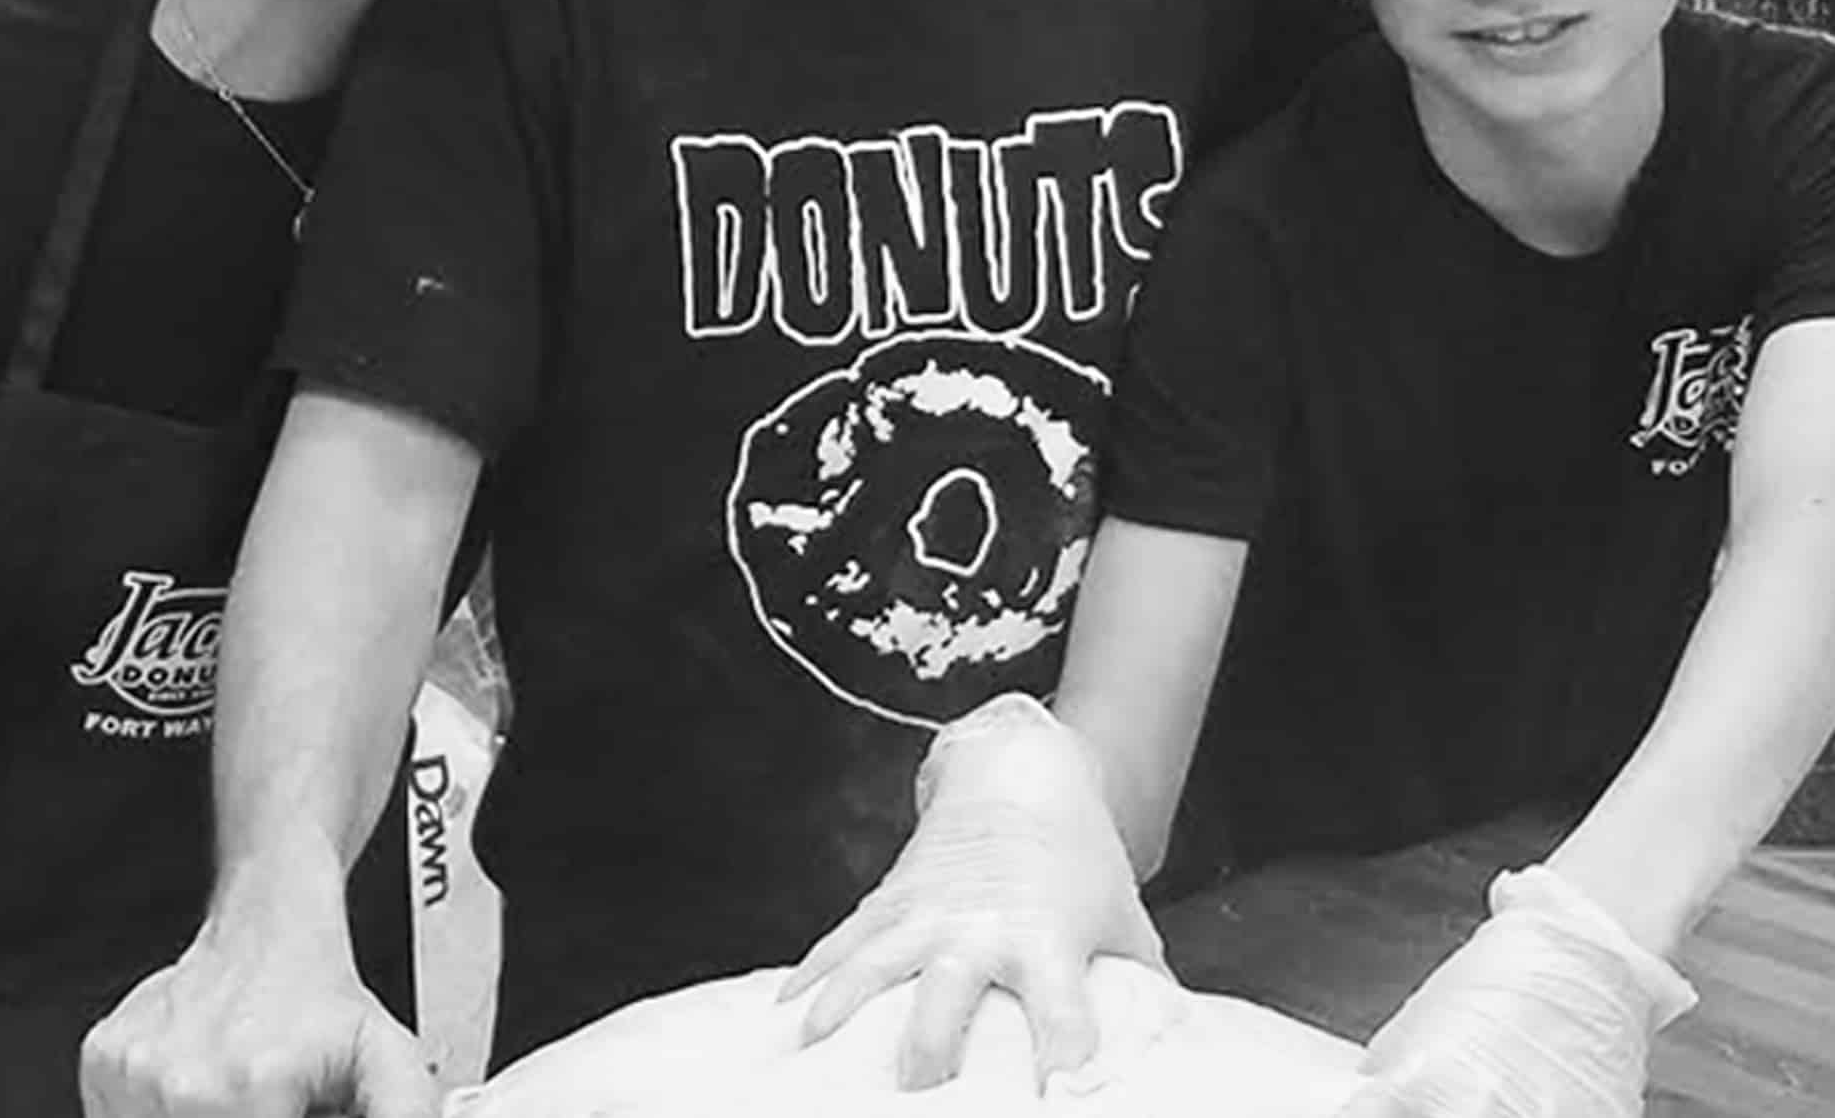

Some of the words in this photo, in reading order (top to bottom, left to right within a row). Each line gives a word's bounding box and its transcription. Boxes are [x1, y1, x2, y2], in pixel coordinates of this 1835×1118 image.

[70, 570, 223, 686] Jac
[120, 663, 216, 690] DONU
[83, 711, 157, 739] FORT
[163, 715, 214, 738] WAY
[411, 755, 451, 908] Dawn
